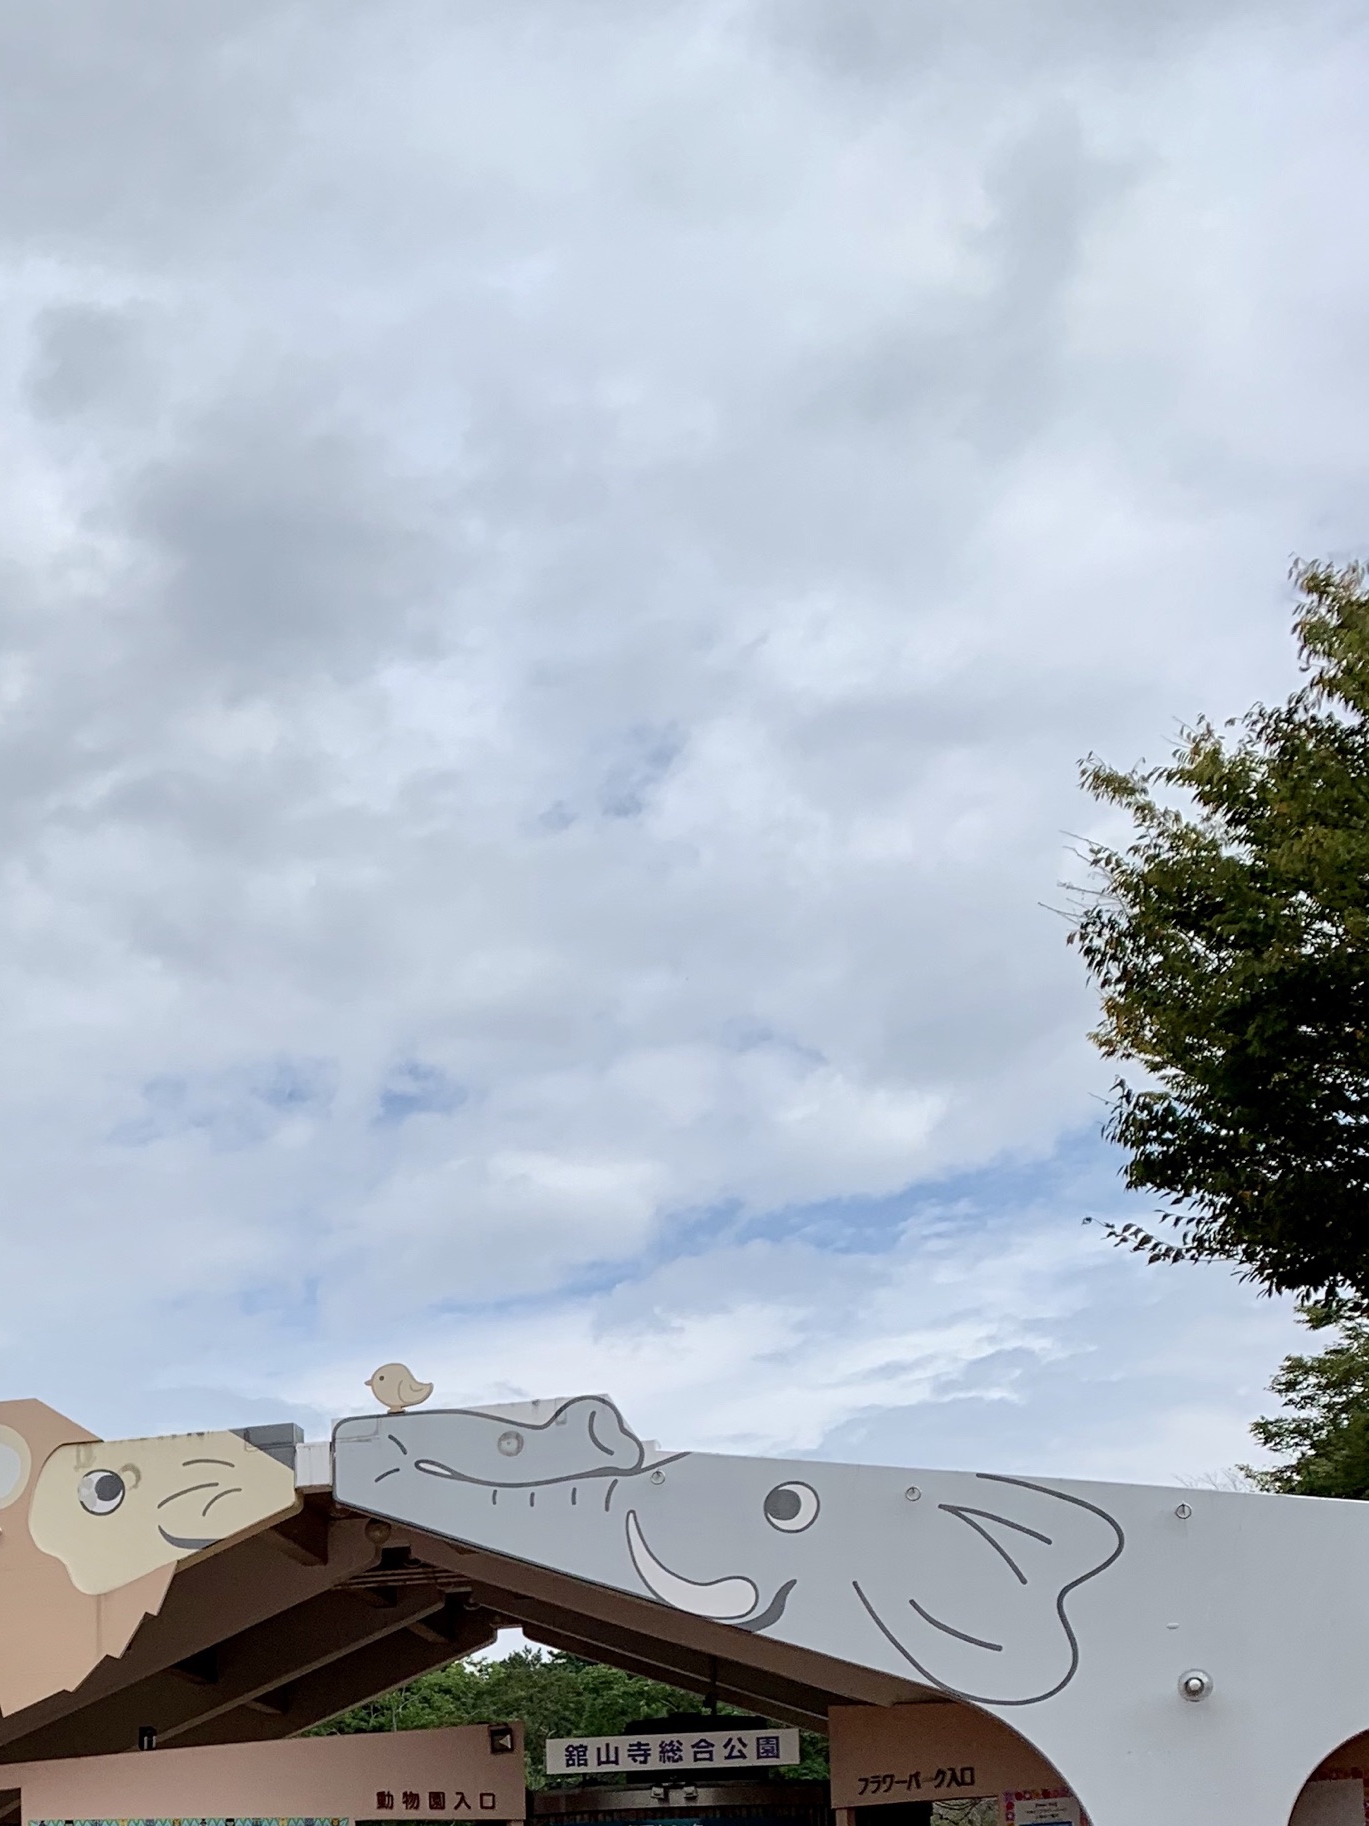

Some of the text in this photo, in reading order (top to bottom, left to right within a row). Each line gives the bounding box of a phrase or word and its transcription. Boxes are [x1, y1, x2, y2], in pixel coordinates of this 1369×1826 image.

[376, 1791, 496, 1810] 動物園入口
